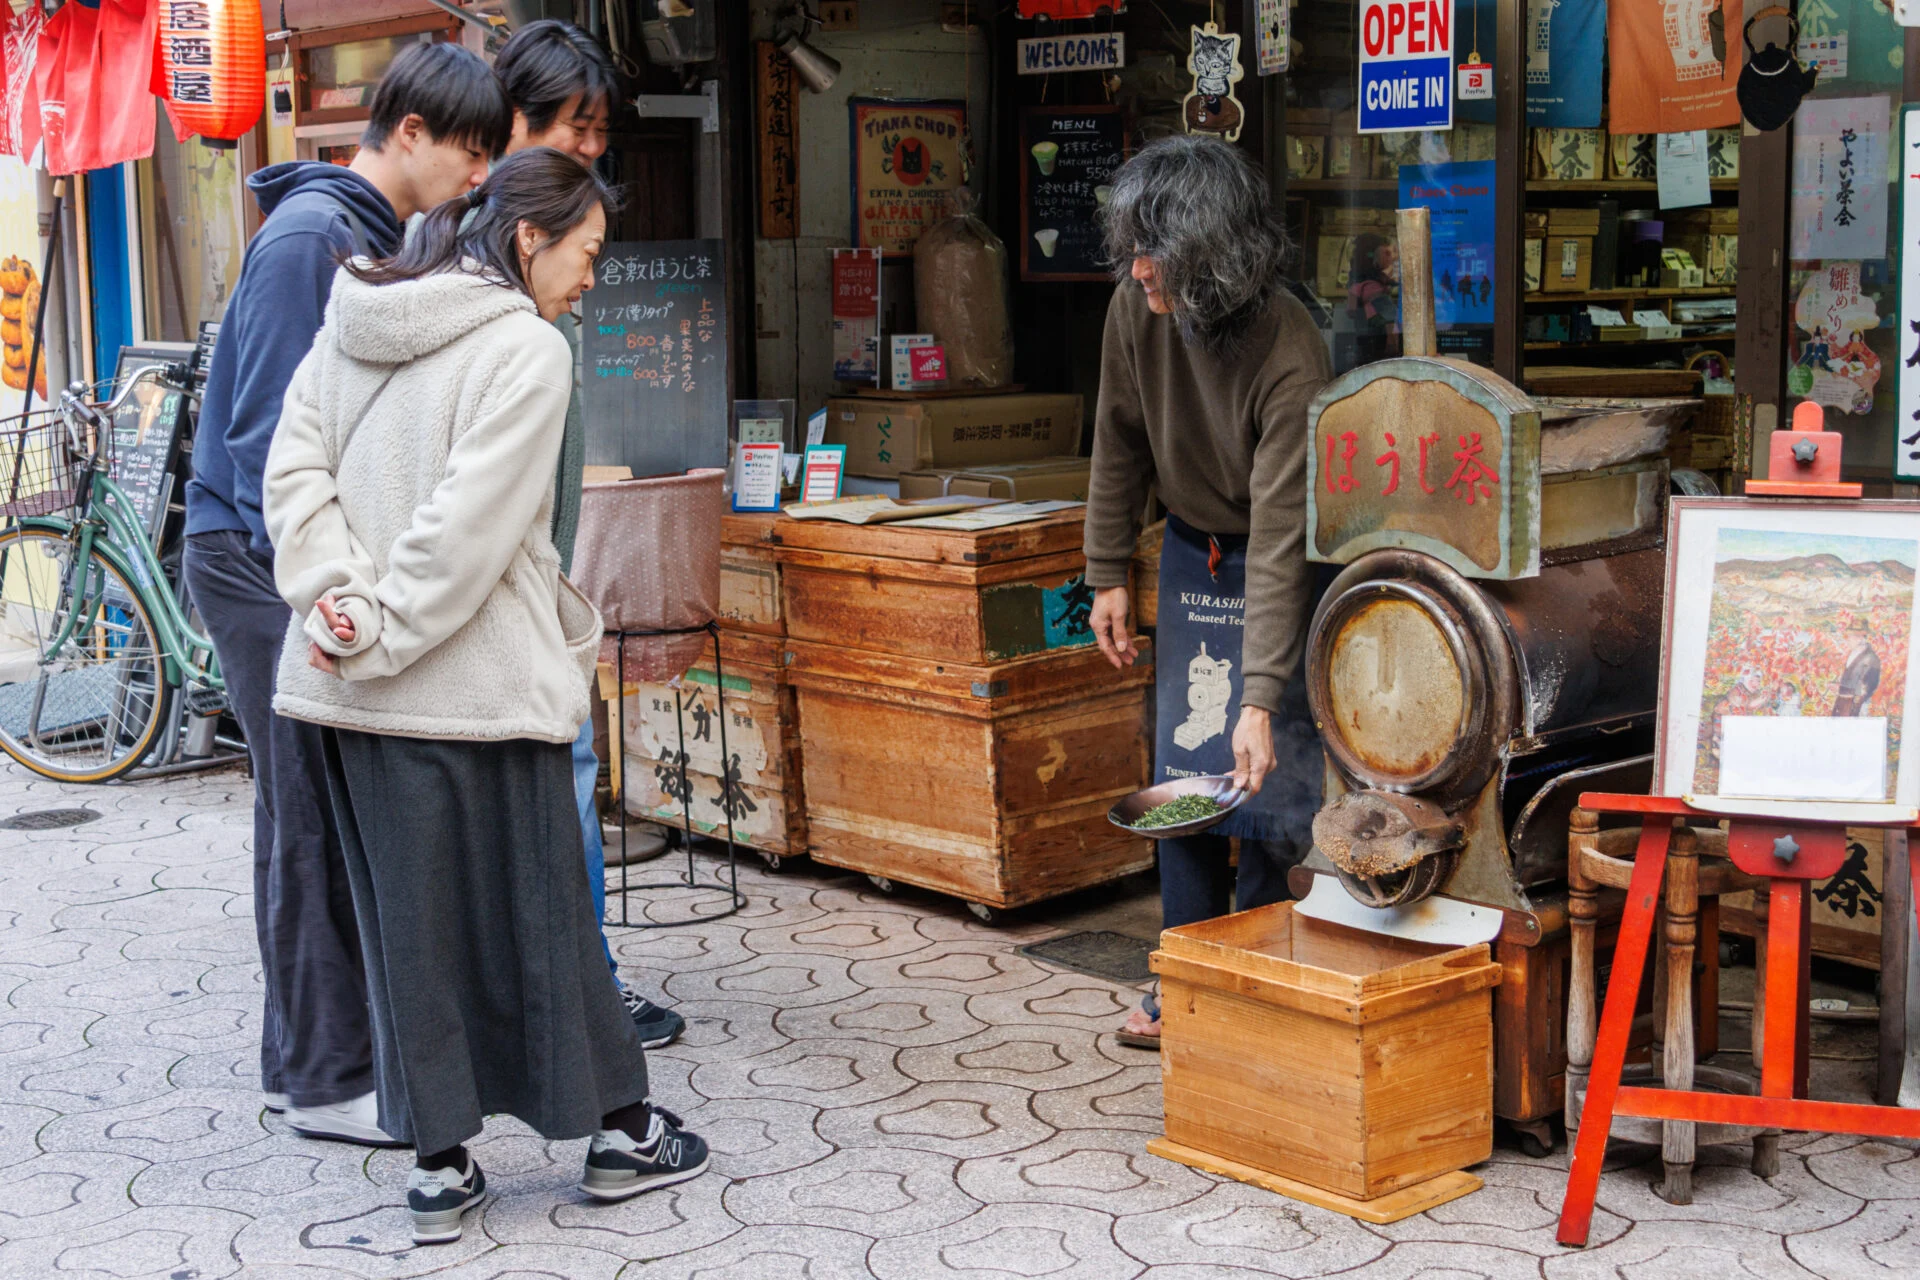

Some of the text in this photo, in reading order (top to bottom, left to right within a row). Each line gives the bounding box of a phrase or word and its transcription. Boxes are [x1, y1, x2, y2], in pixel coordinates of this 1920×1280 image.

[1364, 0, 1448, 56] OPEN
[1025, 38, 1118, 69] WELCOME
[1367, 76, 1444, 110] COME IN
[1051, 119, 1096, 130] MENU
[1409, 184, 1489, 198] Choco Choco
[1833, 127, 1857, 227] やよい茶会
[870, 189, 946, 198] EXTRA CHOICES
[865, 205, 949, 220] JAPAN TE
[600, 255, 711, 285] 倉敷ほうじ茶
[655, 283, 703, 298] green
[697, 298, 716, 343] 上品な
[659, 334, 678, 389] 香りです
[1324, 431, 1499, 505] ほうじ茶
[1180, 592, 1245, 609] KURASHI
[1188, 611, 1245, 626] Roasted Tea
